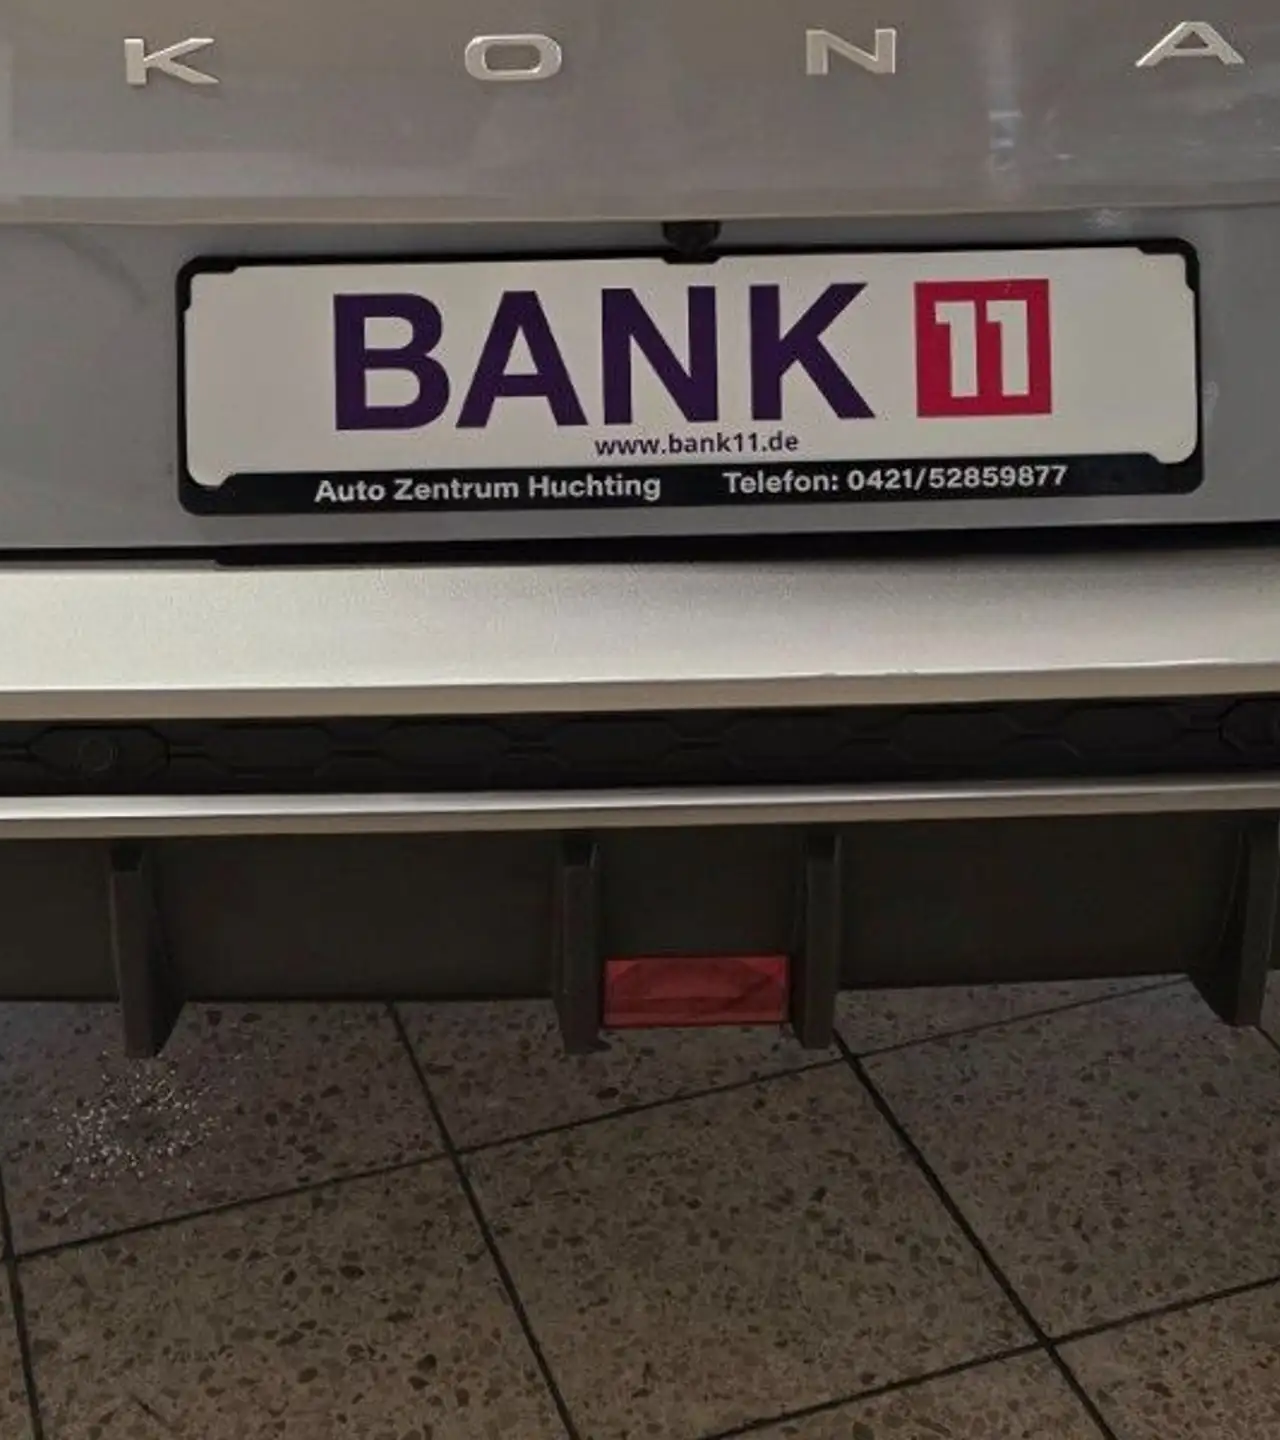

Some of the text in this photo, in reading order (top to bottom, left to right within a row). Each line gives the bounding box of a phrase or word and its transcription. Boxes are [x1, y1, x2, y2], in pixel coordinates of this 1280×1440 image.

[124, 20, 1246, 86] KONA
[332, 282, 1031, 431] BANK 11
[594, 431, 799, 456] www.bank11.de
[314, 464, 1069, 504] Auto Zentrum Huchting Telefon: 0421/52859877
